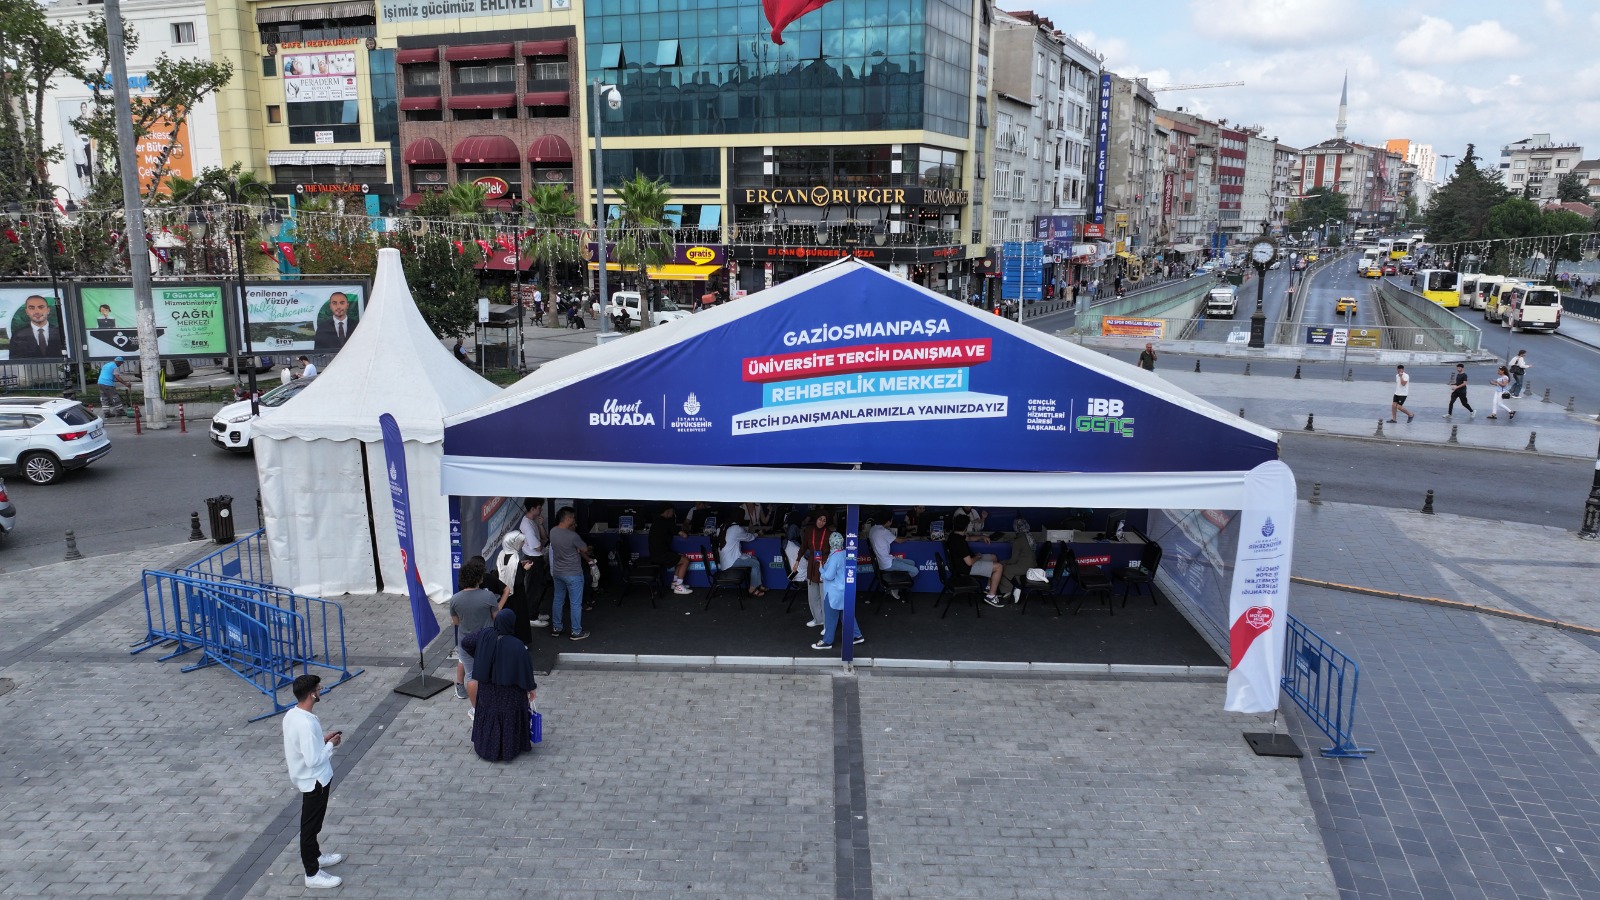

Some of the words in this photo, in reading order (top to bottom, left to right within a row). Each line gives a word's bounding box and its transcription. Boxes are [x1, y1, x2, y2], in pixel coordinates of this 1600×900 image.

[422, 1, 474, 18] gücümüz
[1100, 88, 1110, 142] MURAT
[136, 144, 144, 152] er
[746, 189, 808, 204] ERCAN
[832, 189, 905, 204] BURGER
[923, 190, 944, 204] ERCAN
[690, 249, 712, 259] gratis
[806, 248, 839, 257] BURGER
[264, 298, 299, 306] Yüzüyle
[171, 308, 214, 320] ÇAĞRI
[783, 319, 950, 346] GAZİOSMANPAŞA
[748, 354, 835, 375] ÜNİVERSİTE
[837, 347, 890, 365] TERCİH
[892, 345, 963, 362] DANIŞMA
[965, 345, 985, 357] VE
[772, 376, 875, 402] REHBERLİK
[880, 370, 962, 391] MERKEZİ
[603, 399, 642, 414] Umut
[1028, 398, 1056, 406] GENÇLİK
[590, 413, 655, 426] BURADA
[736, 416, 780, 430] TERCİH
[782, 406, 915, 425] DANIŞMANLARIMIZLA
[1027, 424, 1066, 432] BAŞKANLIĞI
[1076, 416, 1134, 438] GENÇ
